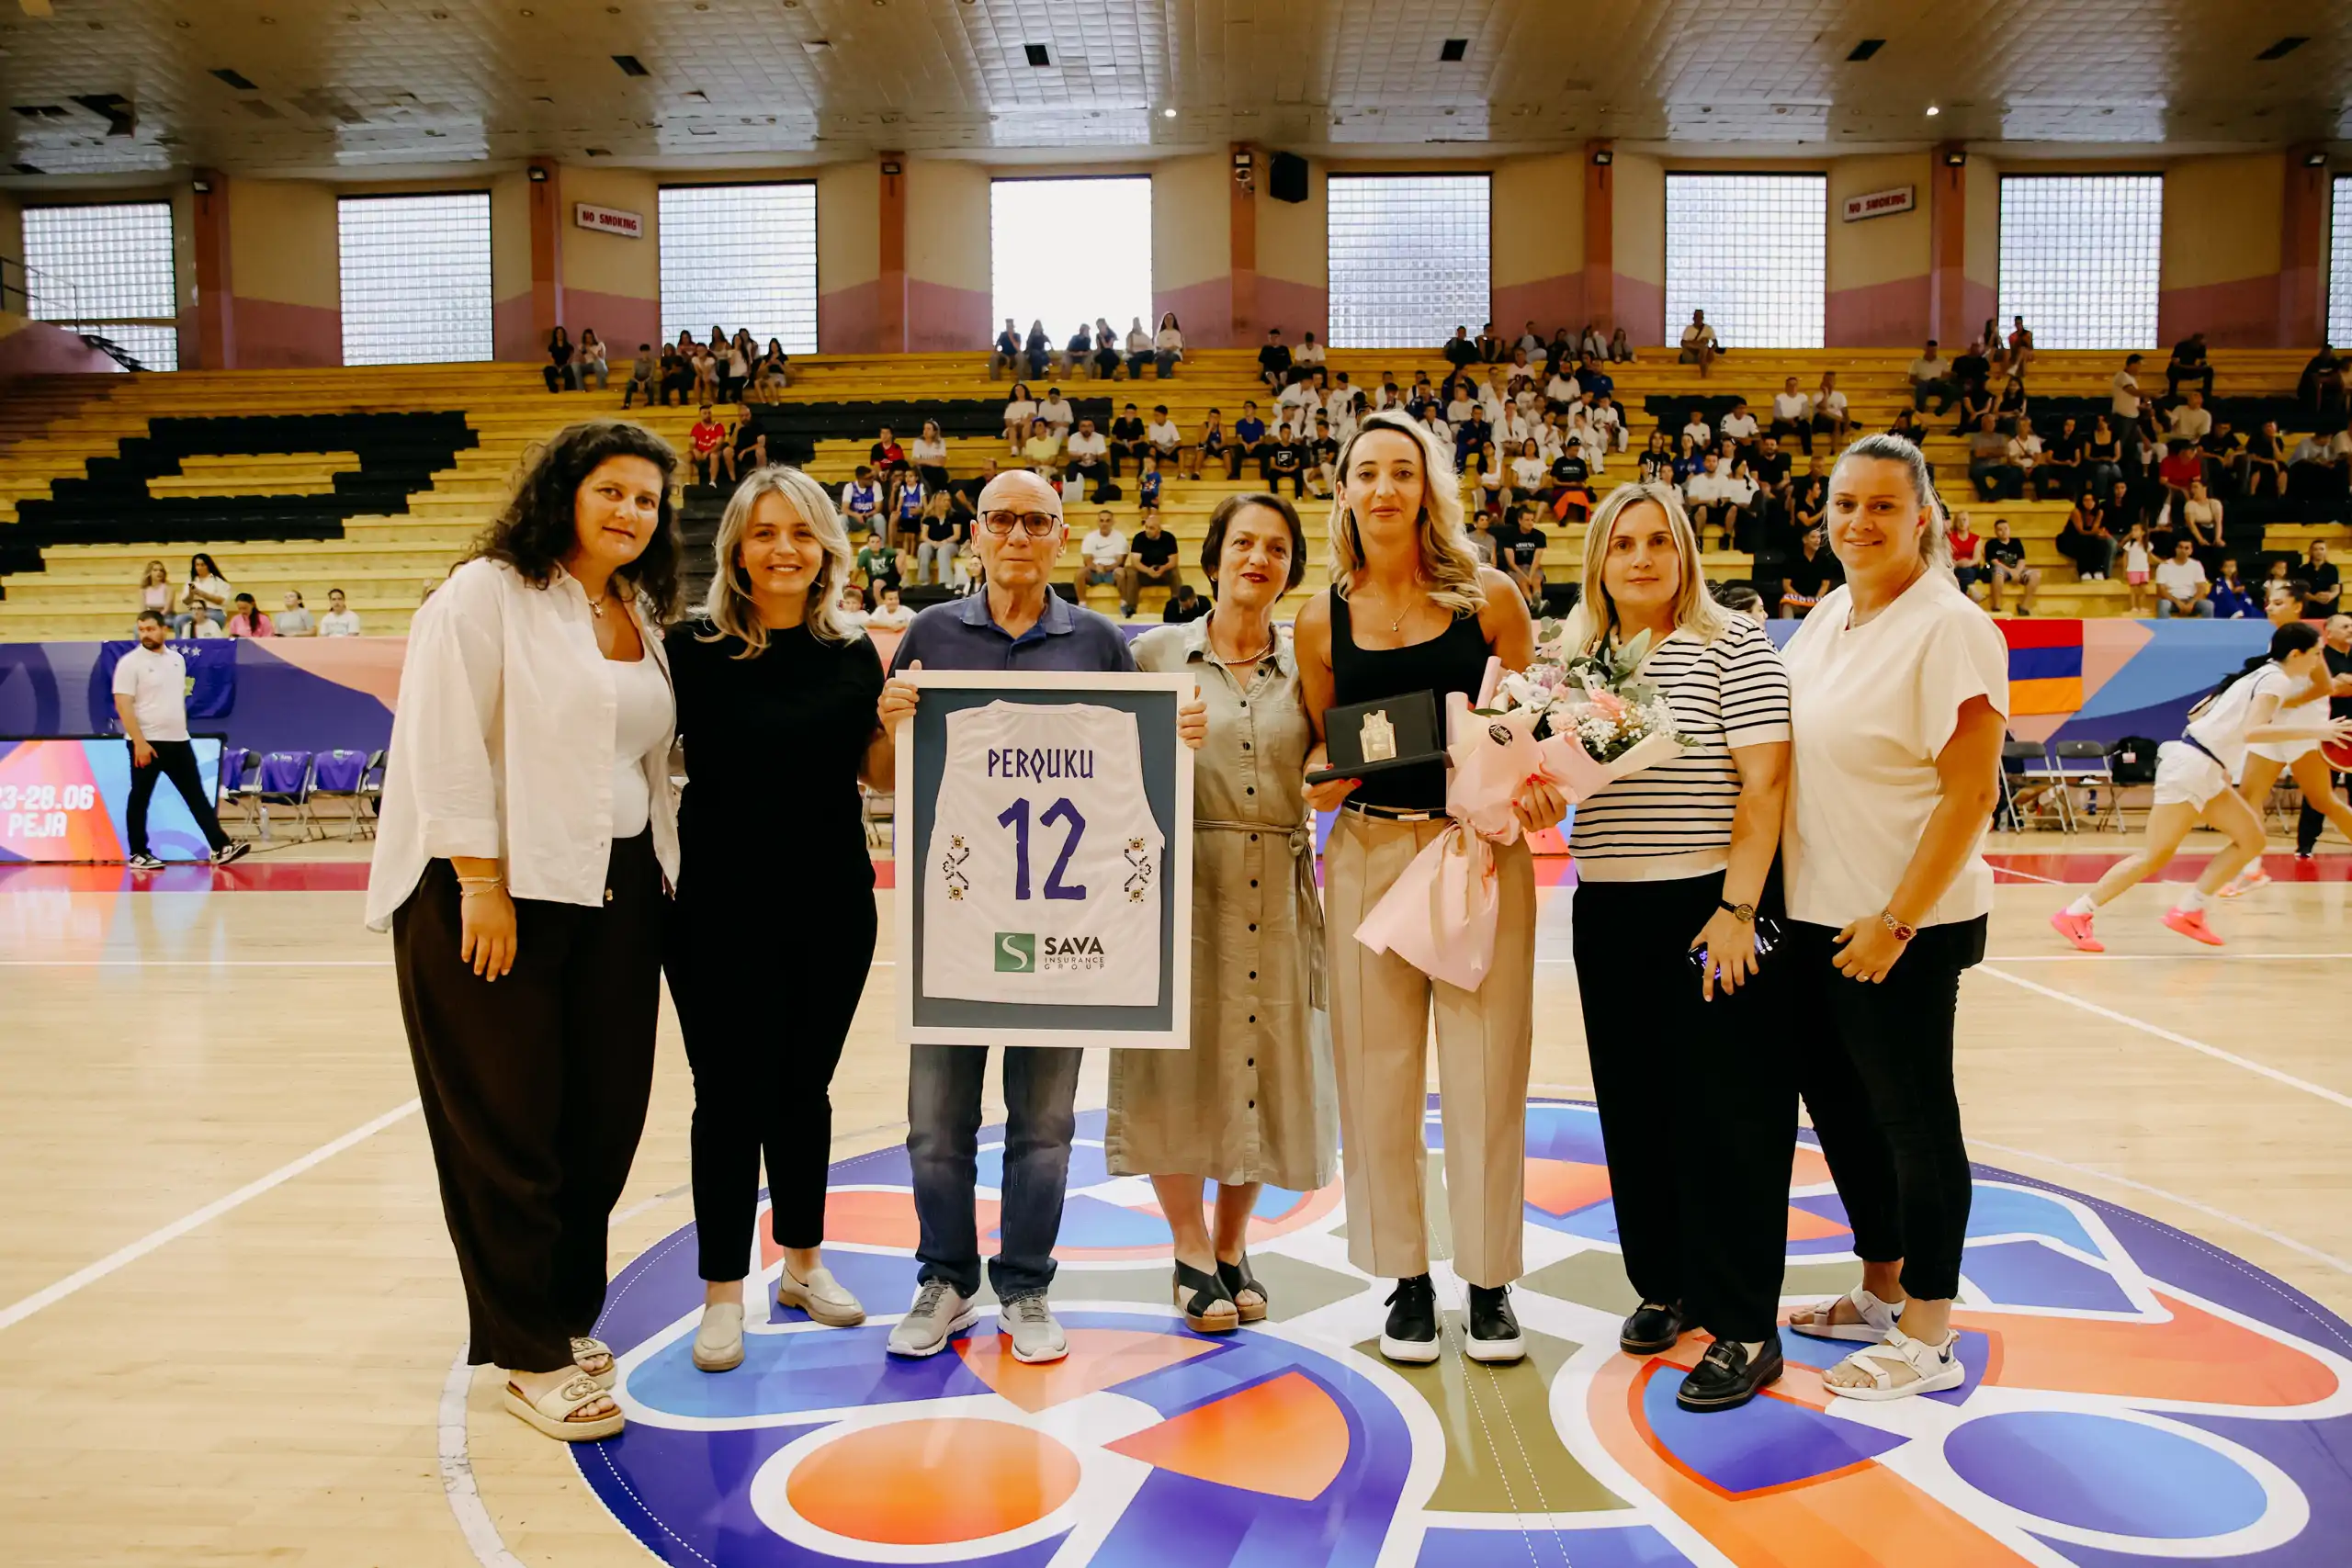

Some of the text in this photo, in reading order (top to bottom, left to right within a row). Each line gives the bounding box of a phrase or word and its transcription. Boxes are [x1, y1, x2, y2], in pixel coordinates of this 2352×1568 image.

[1849, 193, 1906, 214] NO SMOKING
[582, 210, 637, 231] NO SMOKING
[988, 748, 1093, 784] PERQUKU
[0, 784, 96, 810] 3-28.06
[7, 811, 68, 838] PEJA
[997, 797, 1086, 900] 12
[1044, 936, 1104, 955] SAVA
